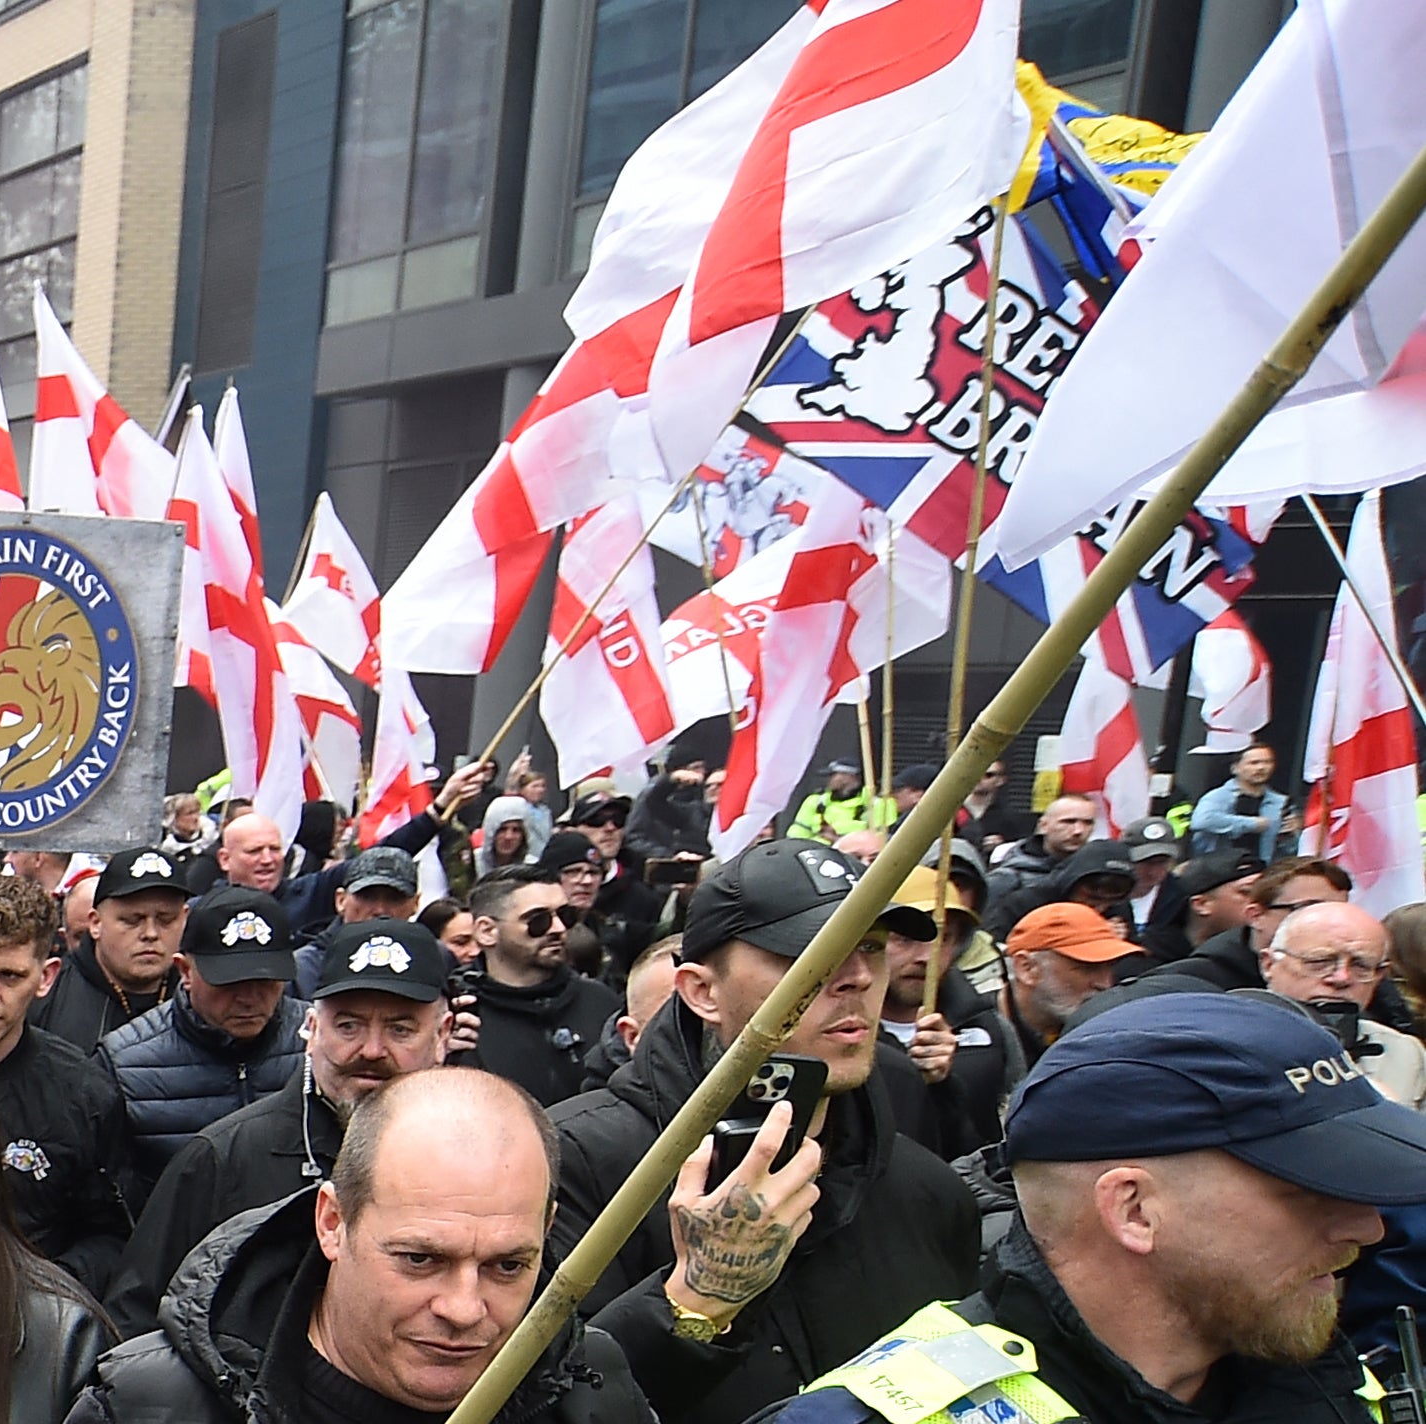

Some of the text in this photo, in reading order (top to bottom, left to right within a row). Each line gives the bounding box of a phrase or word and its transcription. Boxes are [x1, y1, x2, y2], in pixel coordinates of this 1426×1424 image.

[959, 280, 1080, 390] RE
[42, 544, 111, 609] FIRST
[98, 660, 131, 748] BACK
[868, 1374, 924, 1412] 17457
